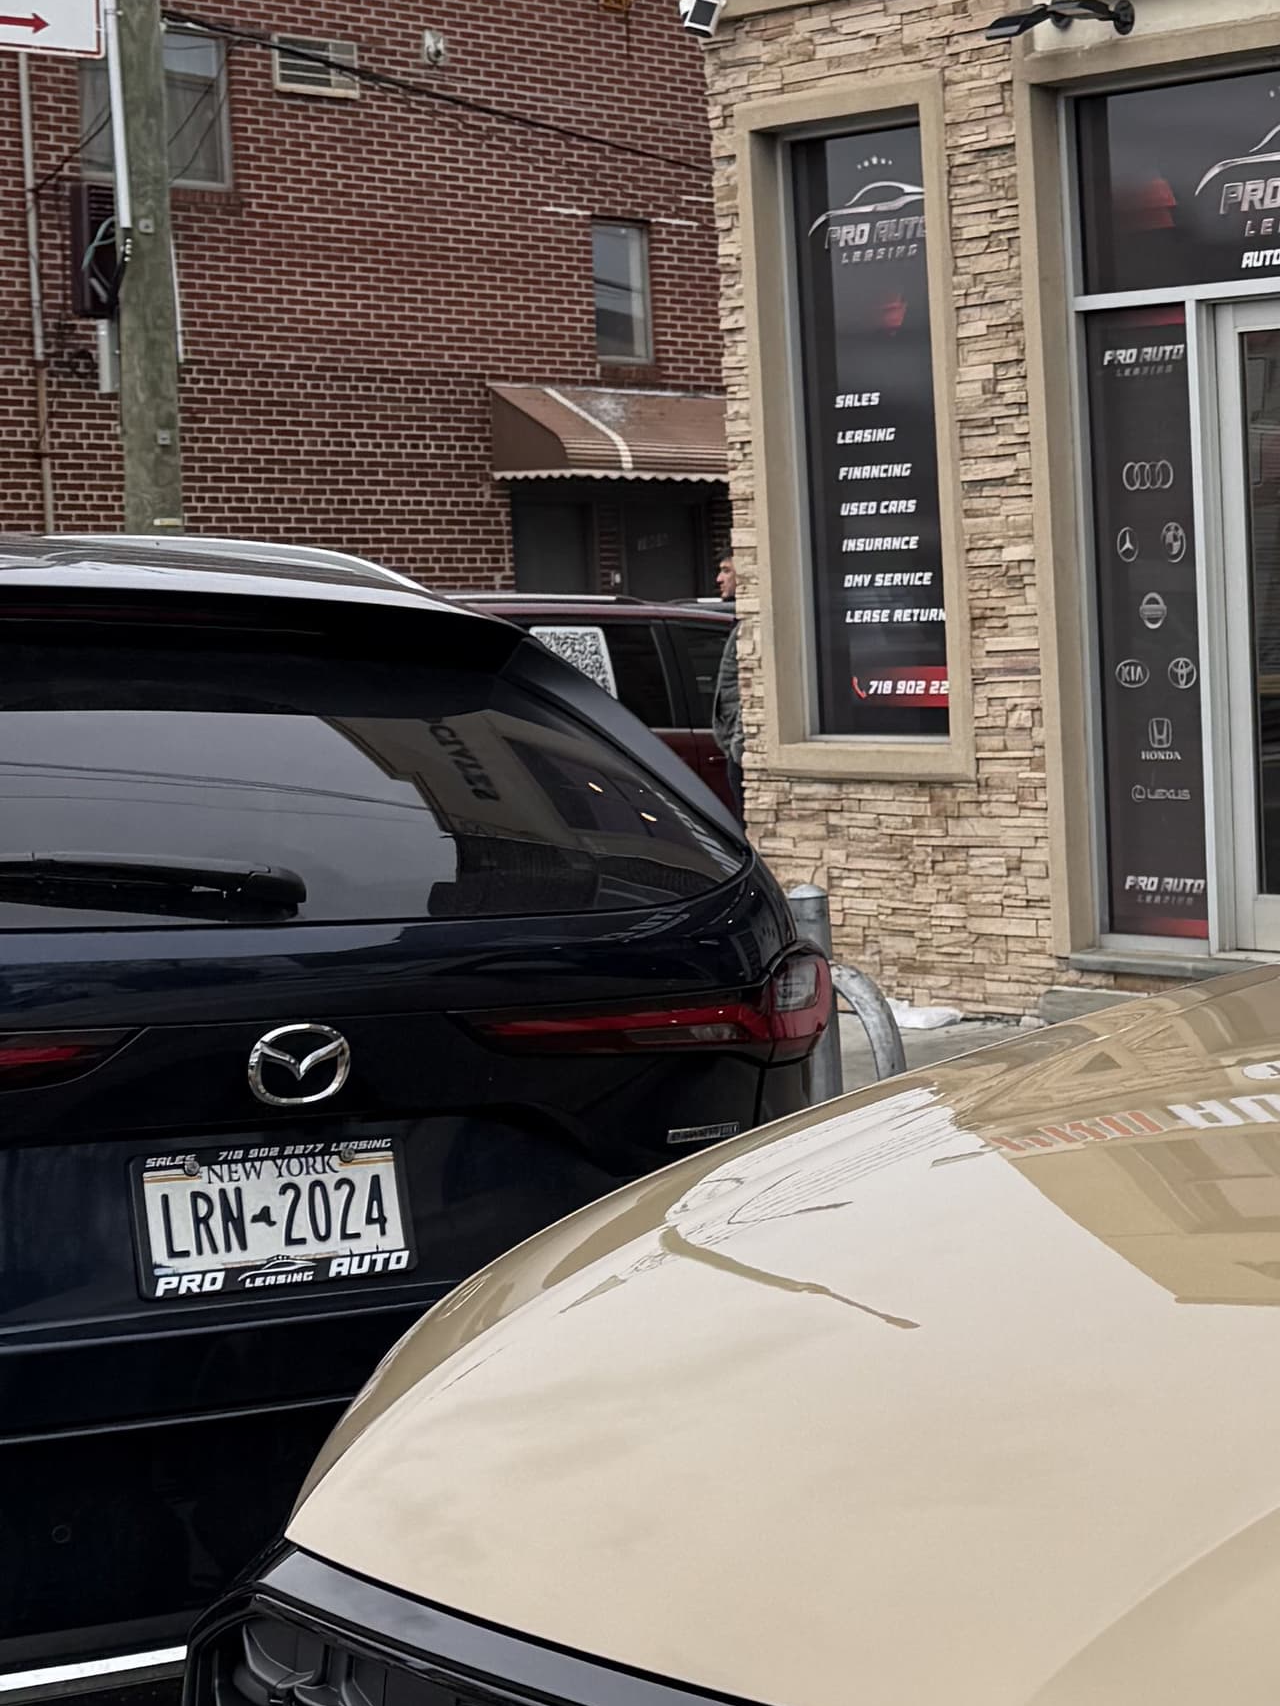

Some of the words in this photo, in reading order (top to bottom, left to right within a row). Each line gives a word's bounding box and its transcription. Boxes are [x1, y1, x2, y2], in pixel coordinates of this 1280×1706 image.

[825, 223, 871, 249] PRO
[842, 244, 918, 263] LEASING
[1103, 348, 1138, 366] PRO
[1139, 343, 1185, 363] AUTO
[834, 392, 880, 408] SALES
[836, 427, 896, 444] LEASING
[838, 463, 912, 480] FINANCING
[840, 501, 877, 516] USED
[879, 499, 917, 514] CARS
[842, 536, 919, 552] INSURANCE
[843, 573, 872, 588] DMV
[874, 572, 932, 587] SERVICE
[845, 609, 890, 623] LEASE
[1121, 665, 1144, 682] KIA
[868, 680, 893, 695] 718
[896, 680, 926, 695] 902
[1141, 751, 1182, 761] HONDA
[1147, 789, 1191, 800] LEXUS
[1125, 876, 1158, 891] PRO
[1161, 877, 1205, 894] AUTO
[145, 1154, 197, 1169] SALES
[218, 1150, 242, 1161] 718
[248, 1147, 279, 1159] 902
[283, 1143, 323, 1156] 2277
[330, 1138, 392, 1153] LEASING
[207, 1161, 263, 1184] NEW
[274, 1155, 340, 1178] YORK
[155, 1271, 226, 1297] PRO
[245, 1271, 314, 1288] LEASING
[328, 1250, 410, 1278] AUTO
